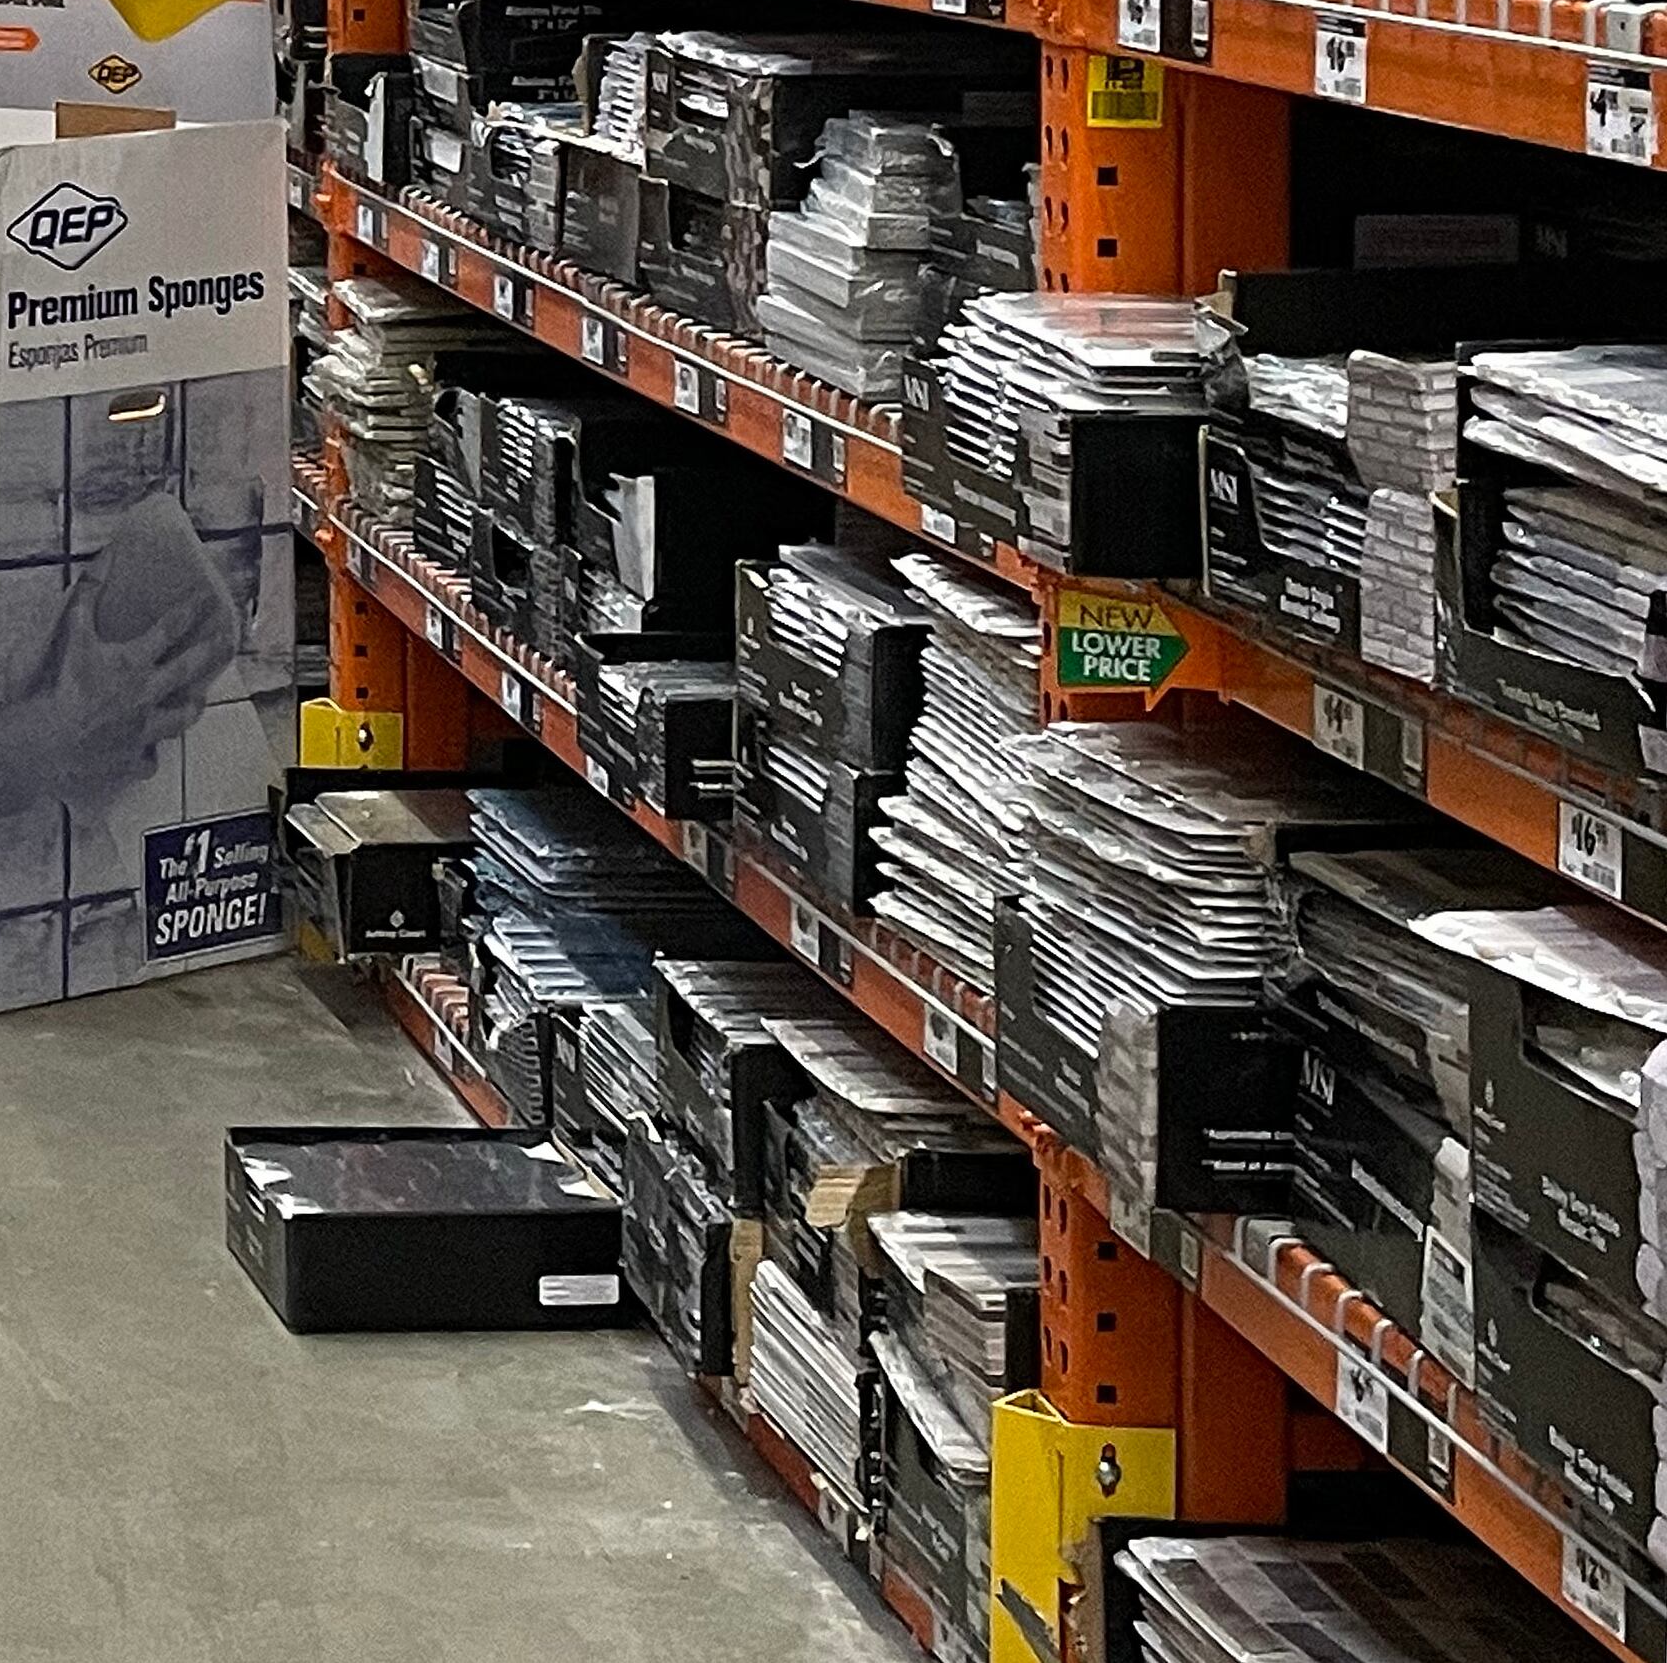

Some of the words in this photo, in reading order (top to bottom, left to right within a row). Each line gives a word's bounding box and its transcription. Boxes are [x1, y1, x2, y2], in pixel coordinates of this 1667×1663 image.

[28, 204, 114, 249] QEP
[7, 283, 139, 330] Premium
[147, 269, 267, 316] Sponges
[1079, 604, 1153, 630] NEW
[1070, 632, 1162, 659] LOWER
[1082, 655, 1152, 682] PRICE
[158, 858, 188, 881] The
[213, 841, 269, 870] Selling
[164, 871, 259, 906] All-Purpose
[155, 892, 268, 946] SPONGE!
